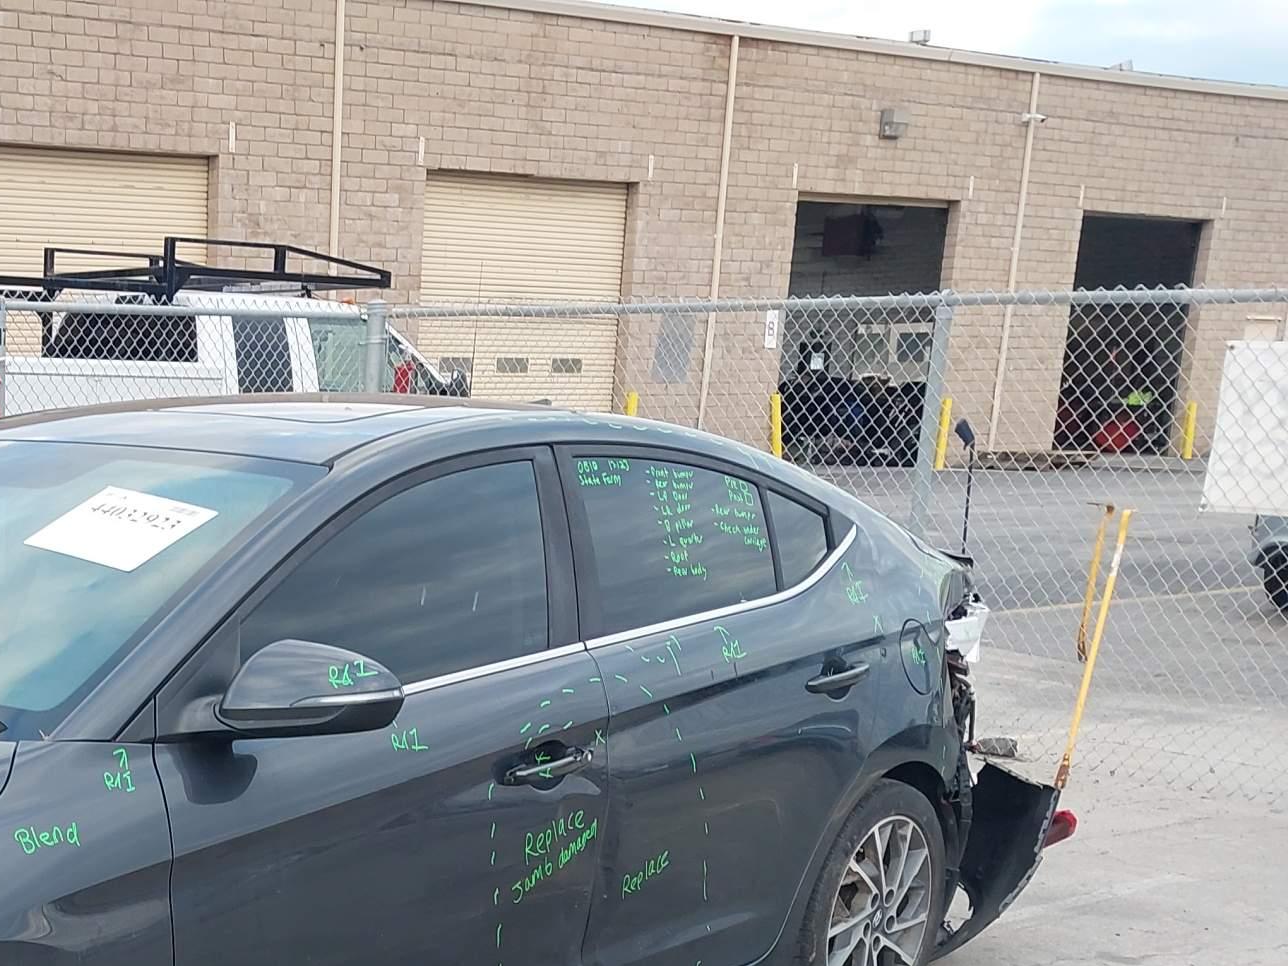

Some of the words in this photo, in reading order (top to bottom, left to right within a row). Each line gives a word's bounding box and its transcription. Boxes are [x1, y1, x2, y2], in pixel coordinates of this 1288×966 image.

[578, 474, 601, 486] State
[601, 472, 622, 487] Farm
[91, 503, 183, 530] 44032923
[14, 822, 80, 854] Blend
[524, 809, 586, 867] Replace
[622, 850, 671, 900] Replace
